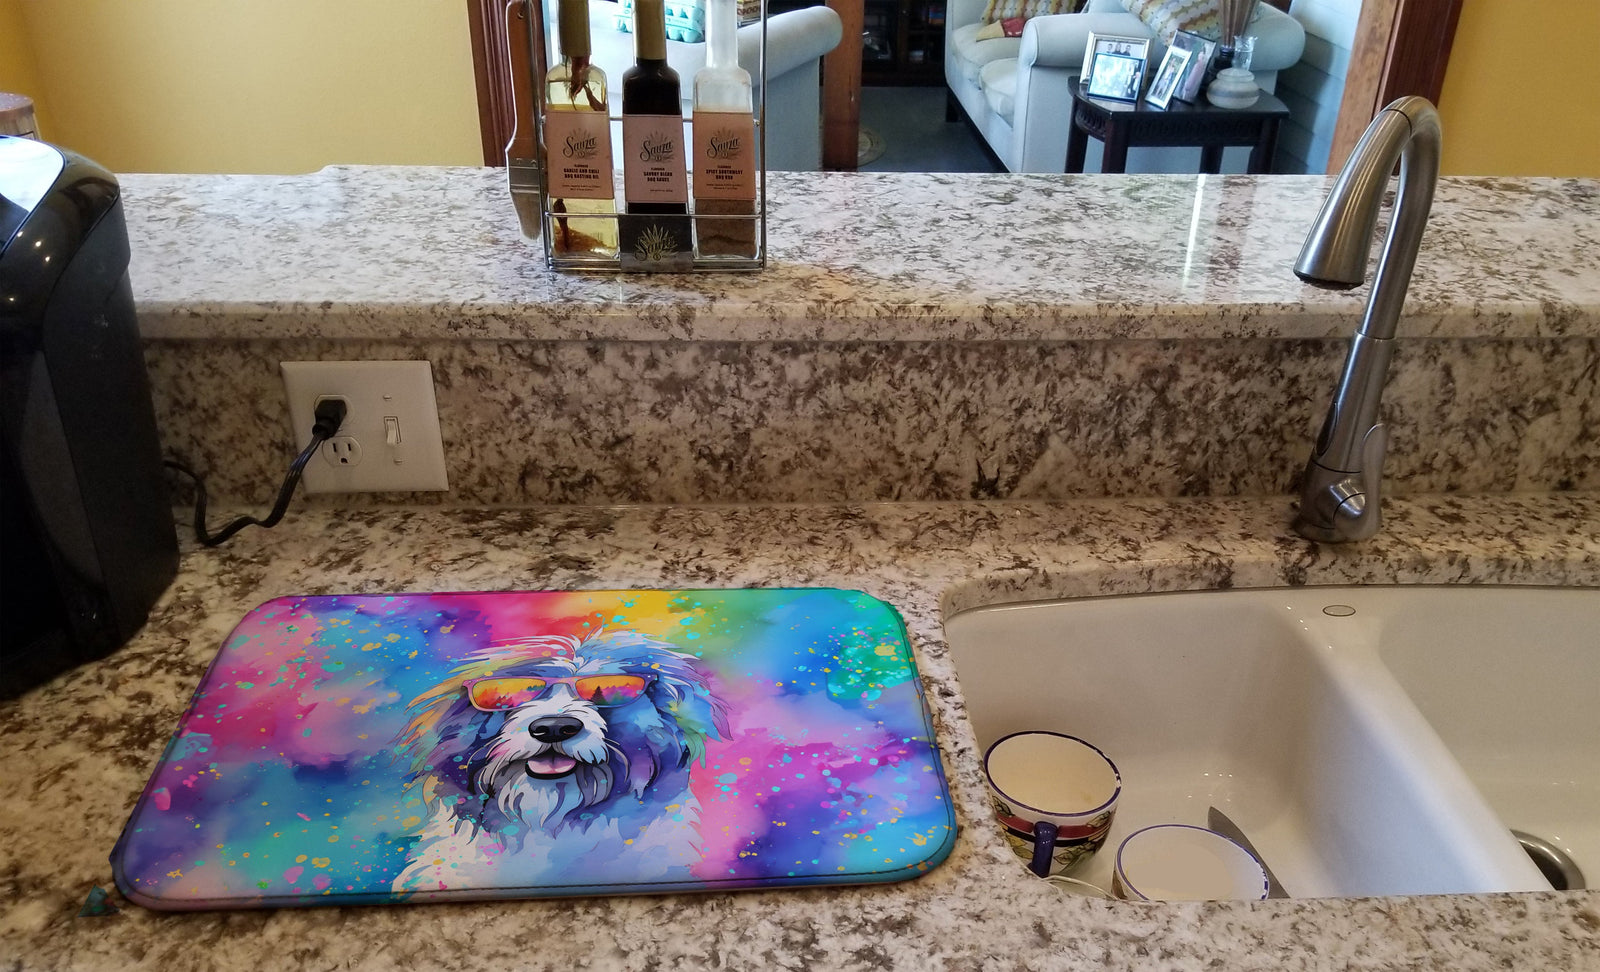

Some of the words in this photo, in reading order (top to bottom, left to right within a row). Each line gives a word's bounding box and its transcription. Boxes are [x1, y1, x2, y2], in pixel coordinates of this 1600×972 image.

[562, 135, 598, 158] Sauza
[639, 140, 674, 162] Sauza
[706, 136, 741, 159] Sauza
